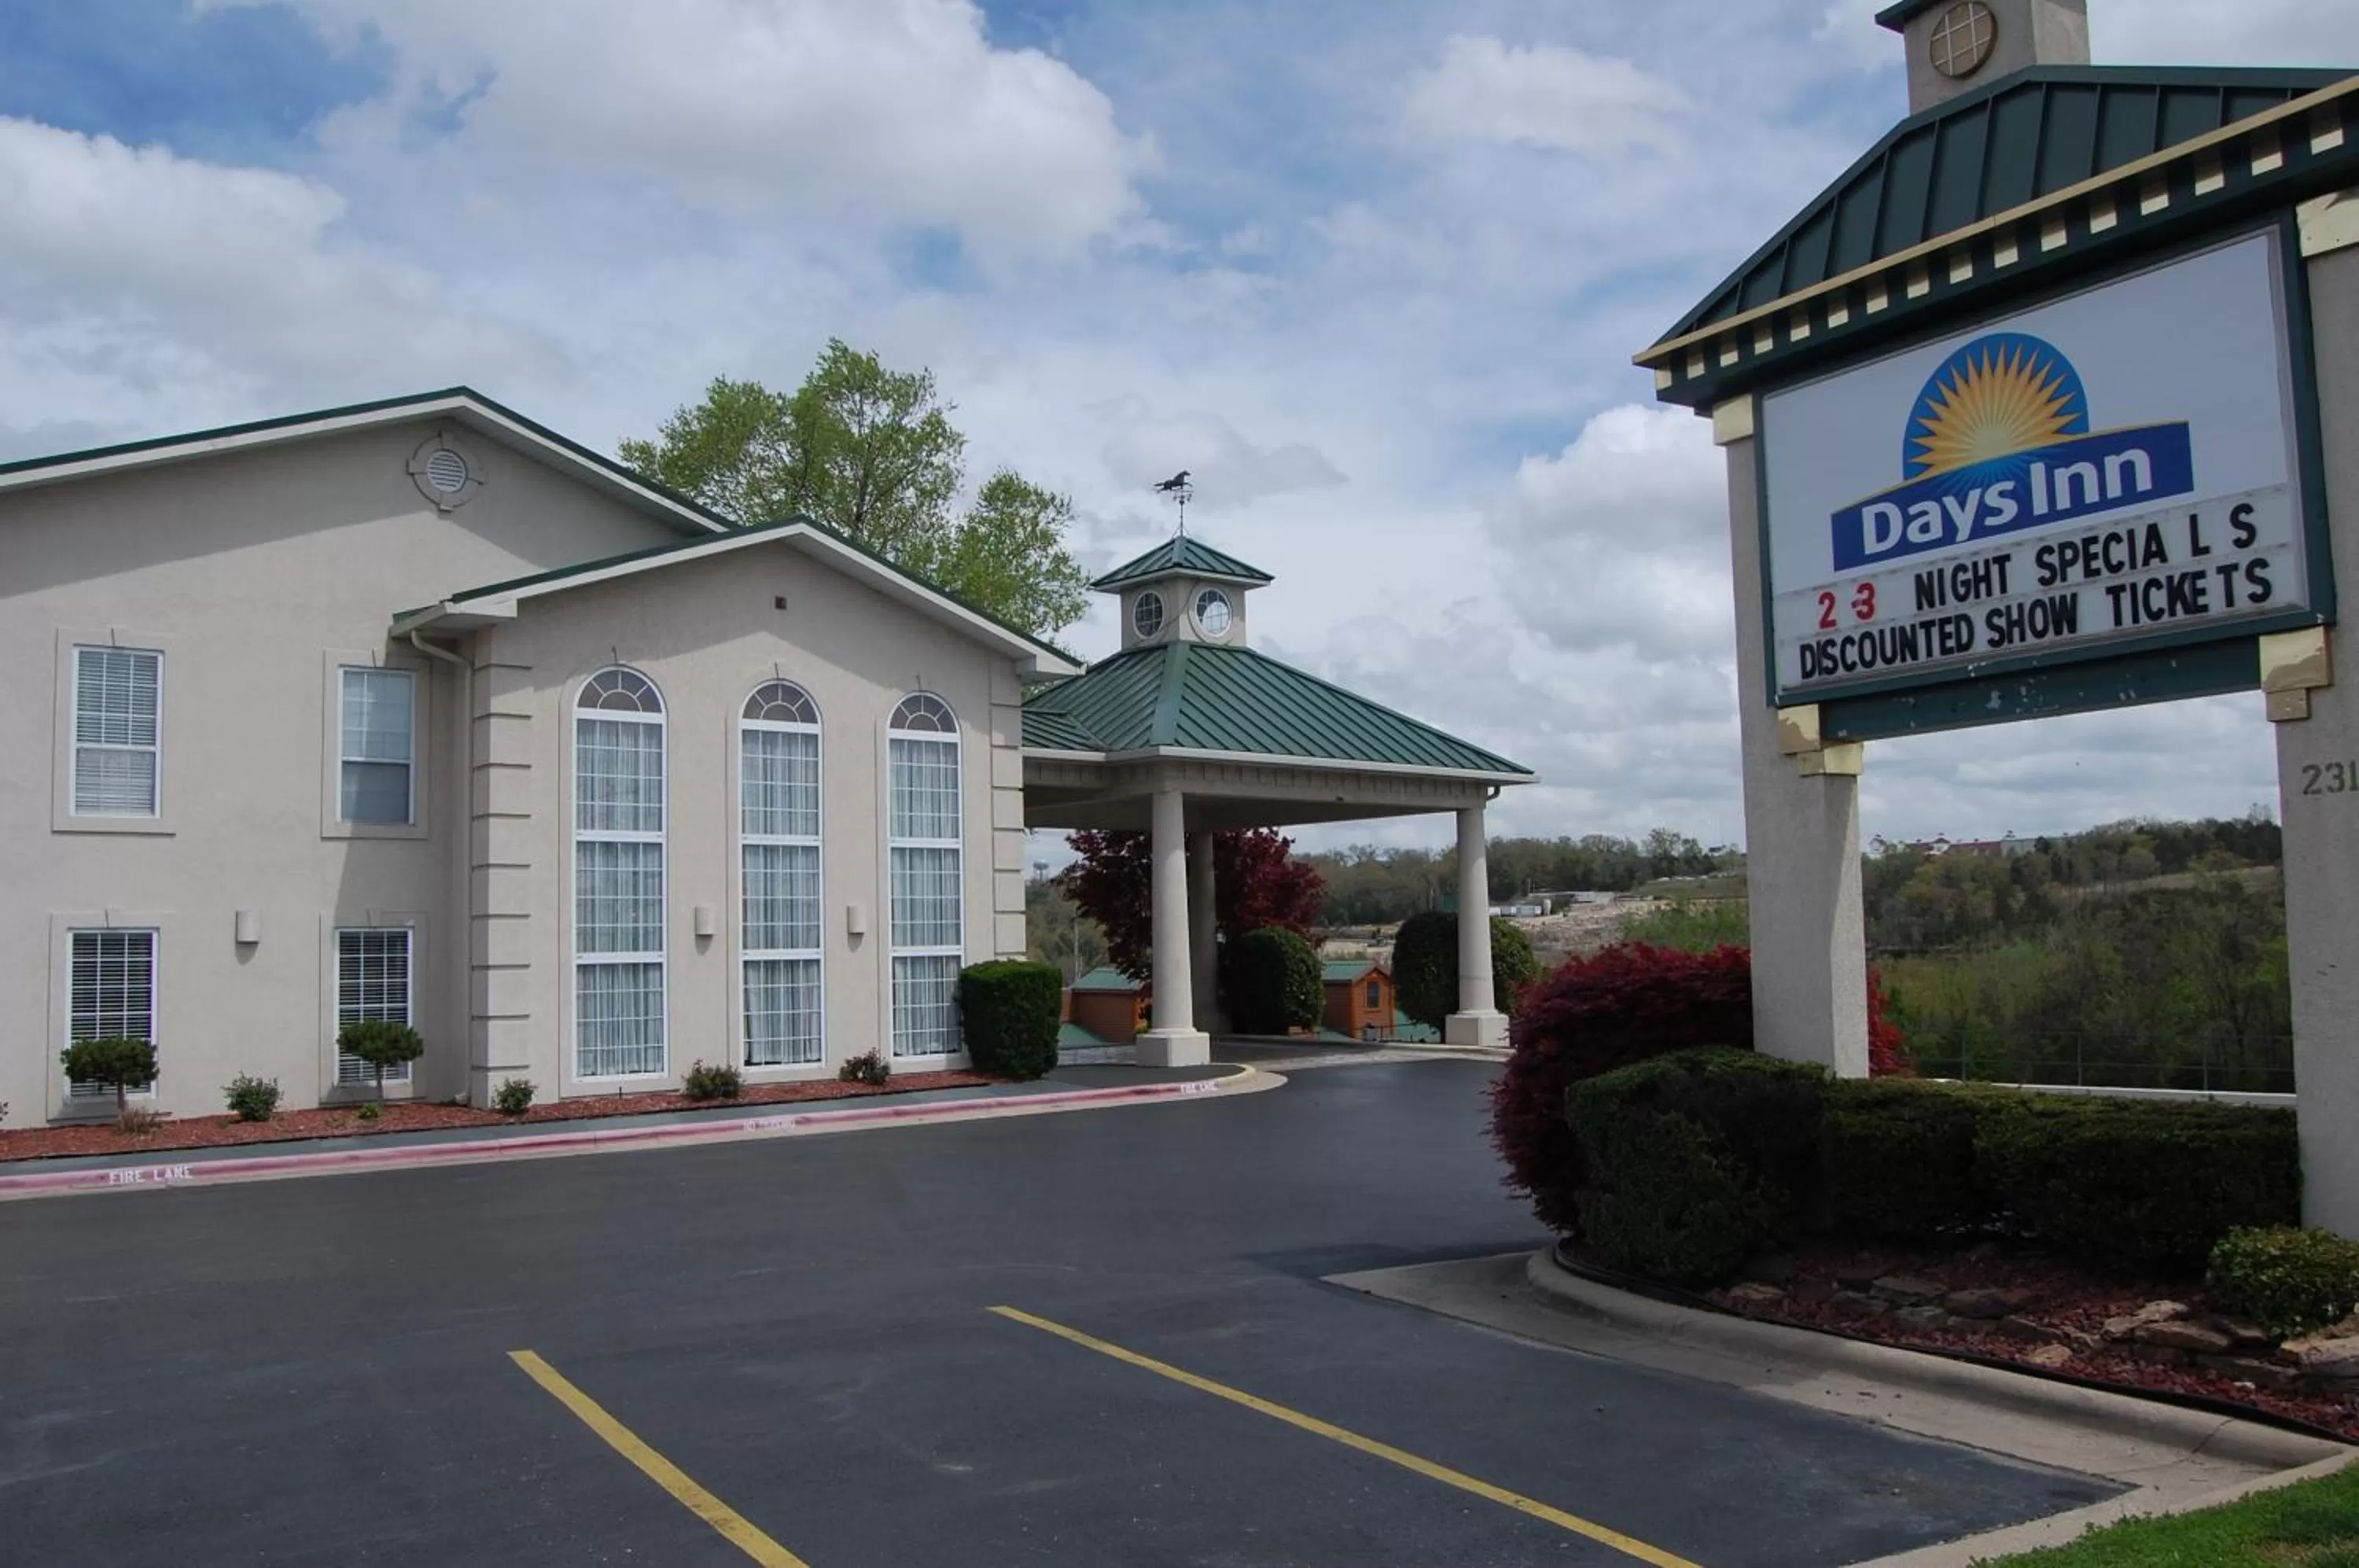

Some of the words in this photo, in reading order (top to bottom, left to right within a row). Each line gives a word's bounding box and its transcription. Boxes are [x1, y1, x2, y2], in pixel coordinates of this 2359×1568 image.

[1860, 480, 2019, 555] Days
[2029, 447, 2153, 517] Inn
[1915, 554, 2011, 611] NIGHT
[1799, 613, 1975, 680] DISCOUNTED
[1985, 591, 2078, 649] SHOW
[2105, 557, 2273, 628] TICKETS
[2302, 760, 2359, 796] 231
[109, 1169, 145, 1184] FIRE
[153, 1163, 193, 1180] LANE
